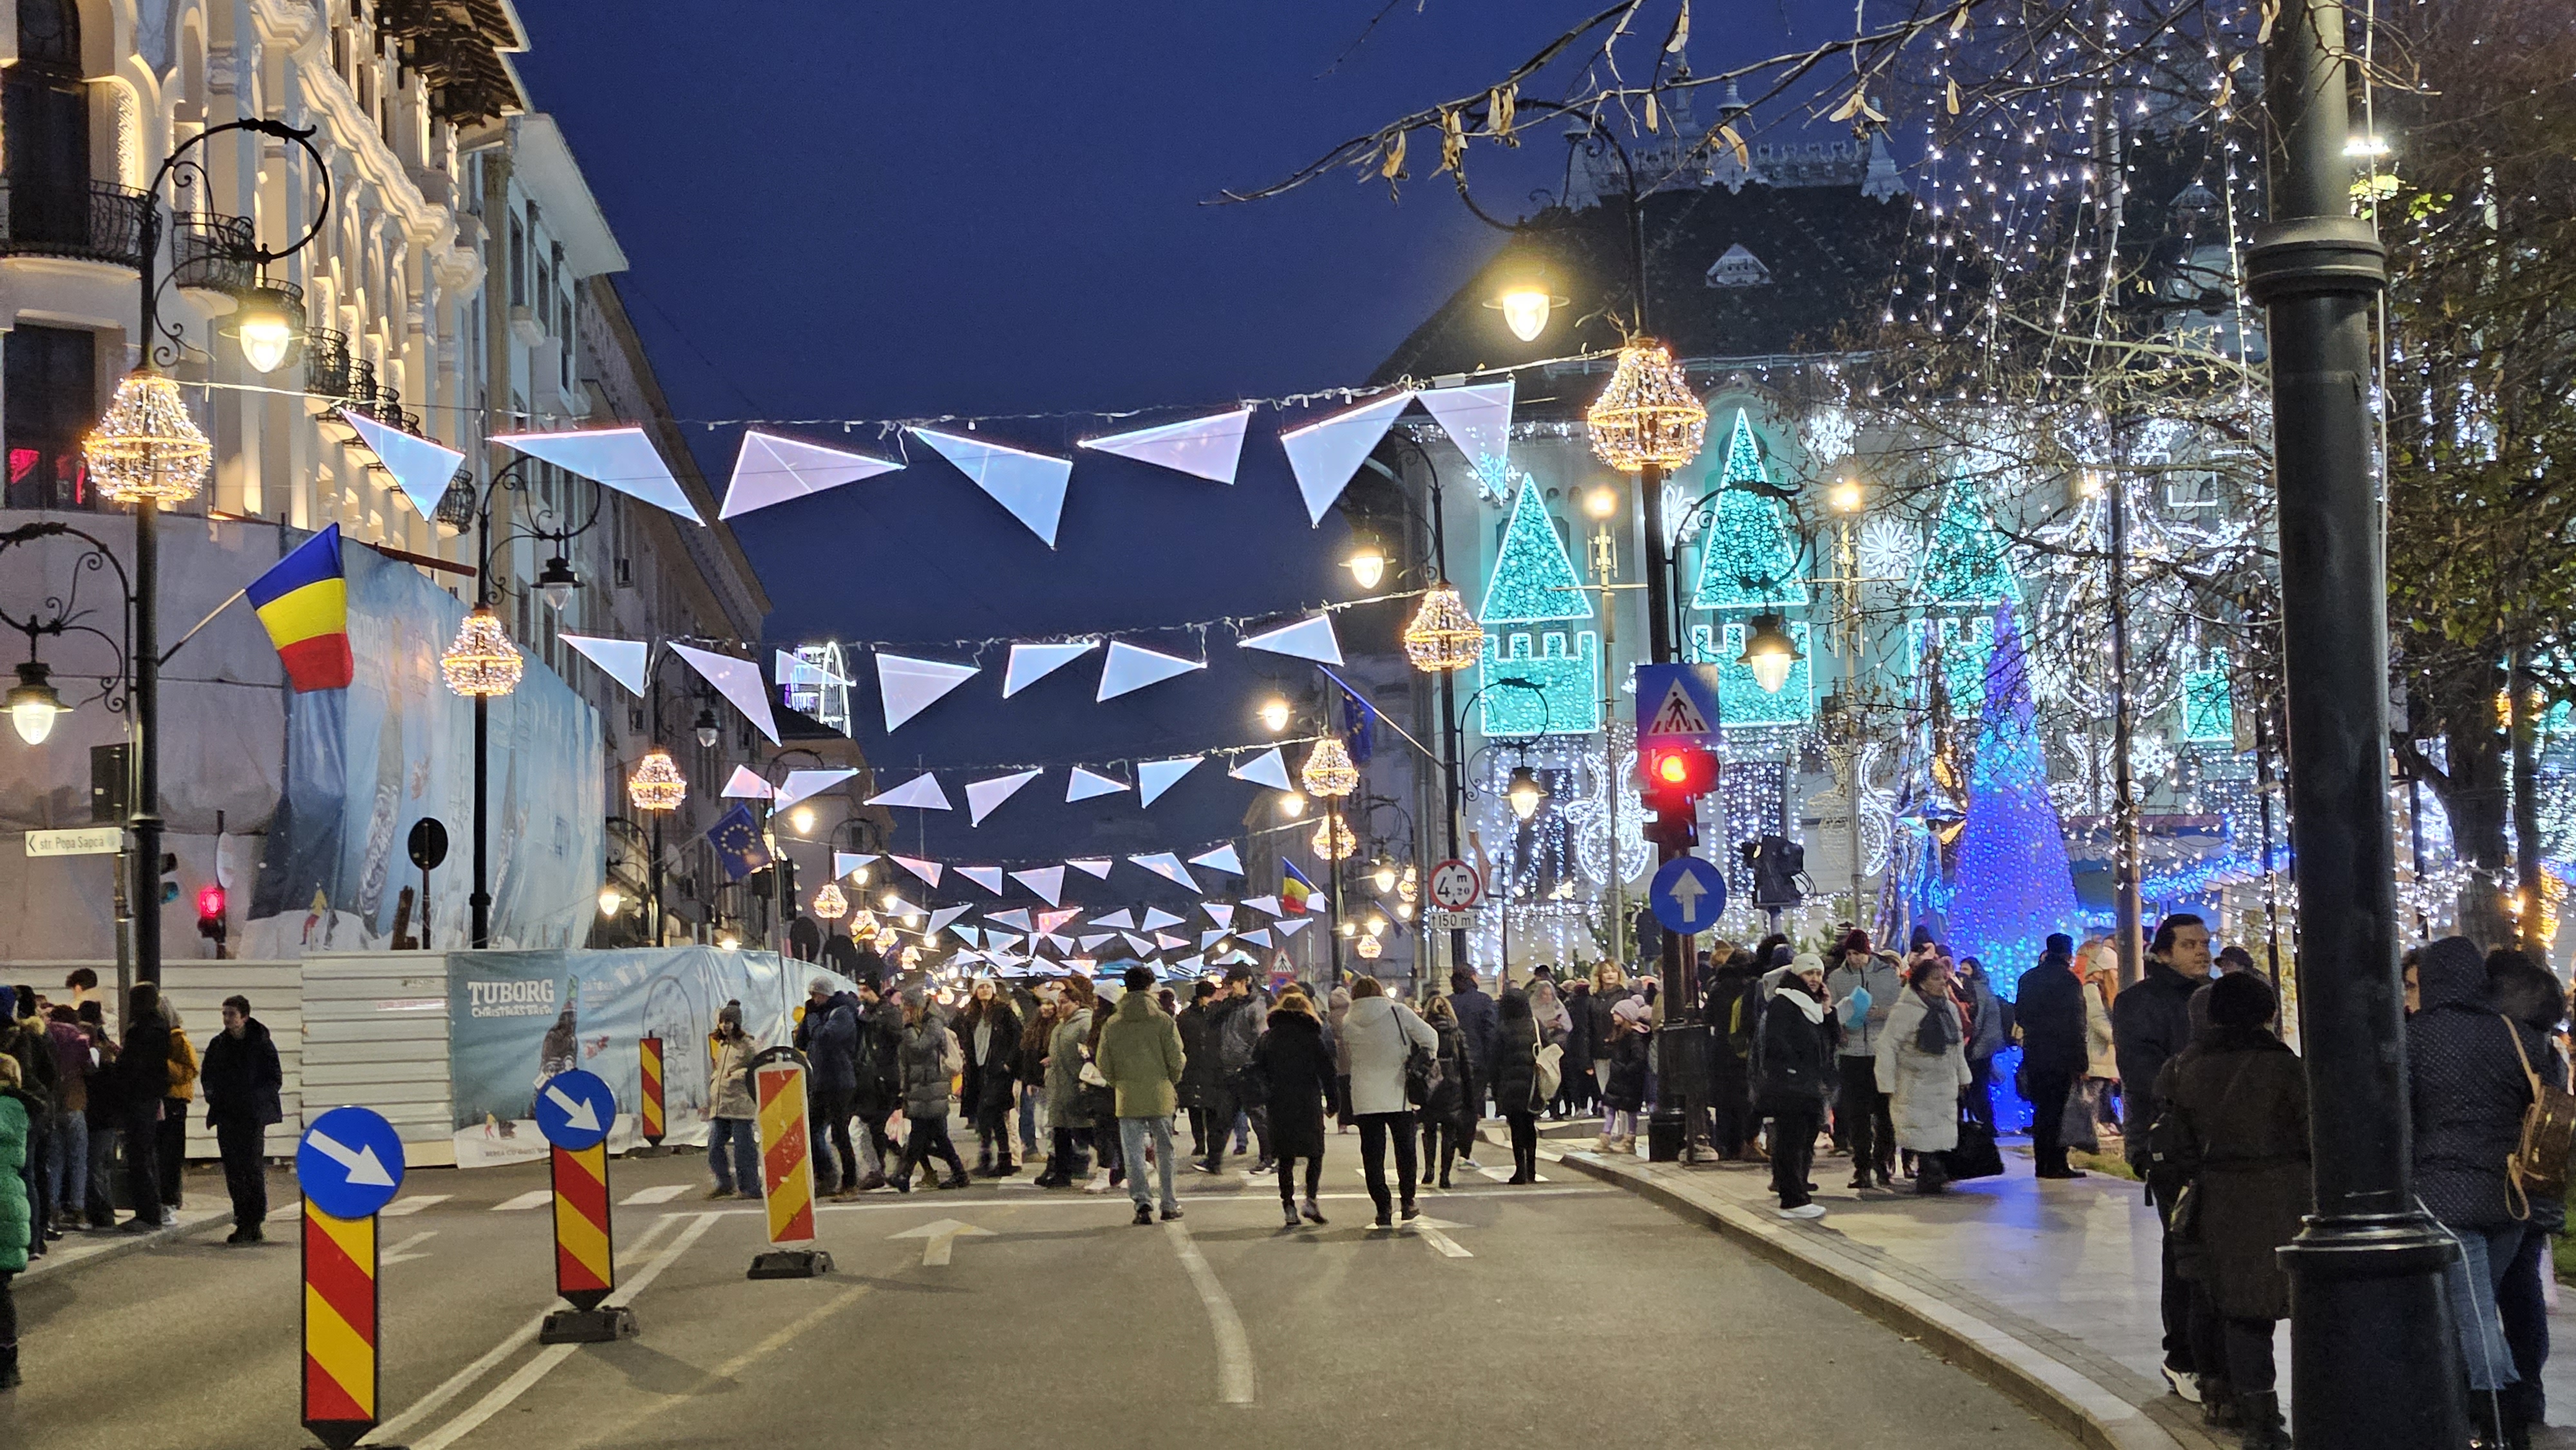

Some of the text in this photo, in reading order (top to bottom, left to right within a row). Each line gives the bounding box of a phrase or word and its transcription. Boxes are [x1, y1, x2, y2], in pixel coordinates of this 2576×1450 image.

[55, 836, 76, 852] Popa
[1439, 914, 1457, 927] 150
[467, 978, 555, 1006] TUBORG
[471, 1004, 526, 1018] CHRISTMAS
